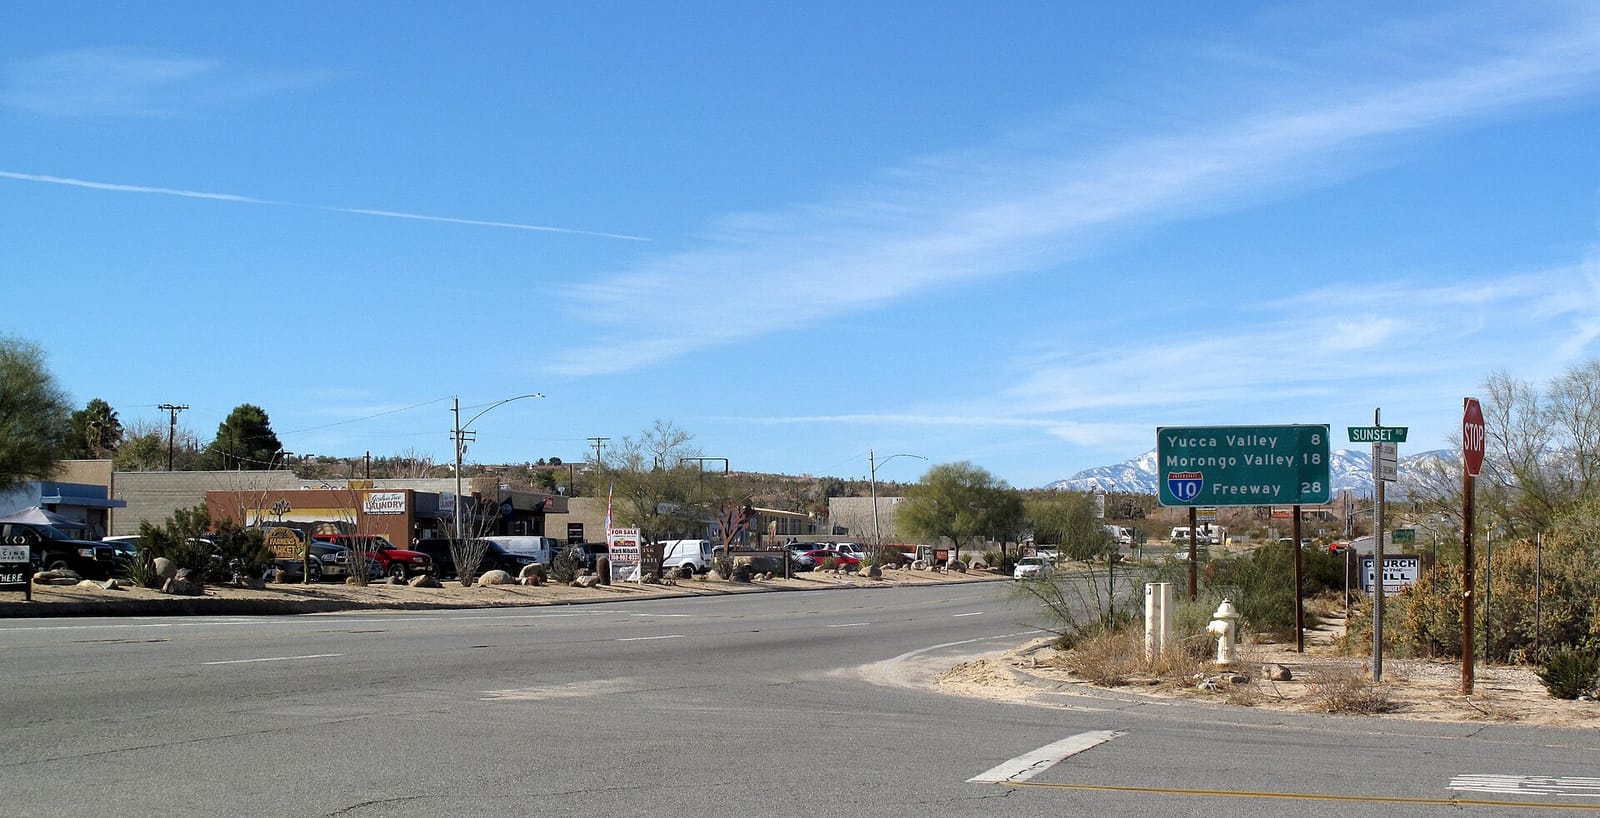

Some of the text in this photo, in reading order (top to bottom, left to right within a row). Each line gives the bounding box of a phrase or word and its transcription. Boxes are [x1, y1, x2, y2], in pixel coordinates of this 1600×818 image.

[1167, 434, 1321, 448] Yucca Valley 8
[1353, 429, 1392, 440] SUNSET
[1464, 422, 1484, 451] STOP
[1166, 453, 1321, 469] Morongo Valley 18
[1177, 482, 1197, 497] 10
[1213, 482, 1321, 496] Freeway 28
[365, 501, 403, 509] LAUNDRY
[1364, 560, 1416, 568] CURCH
